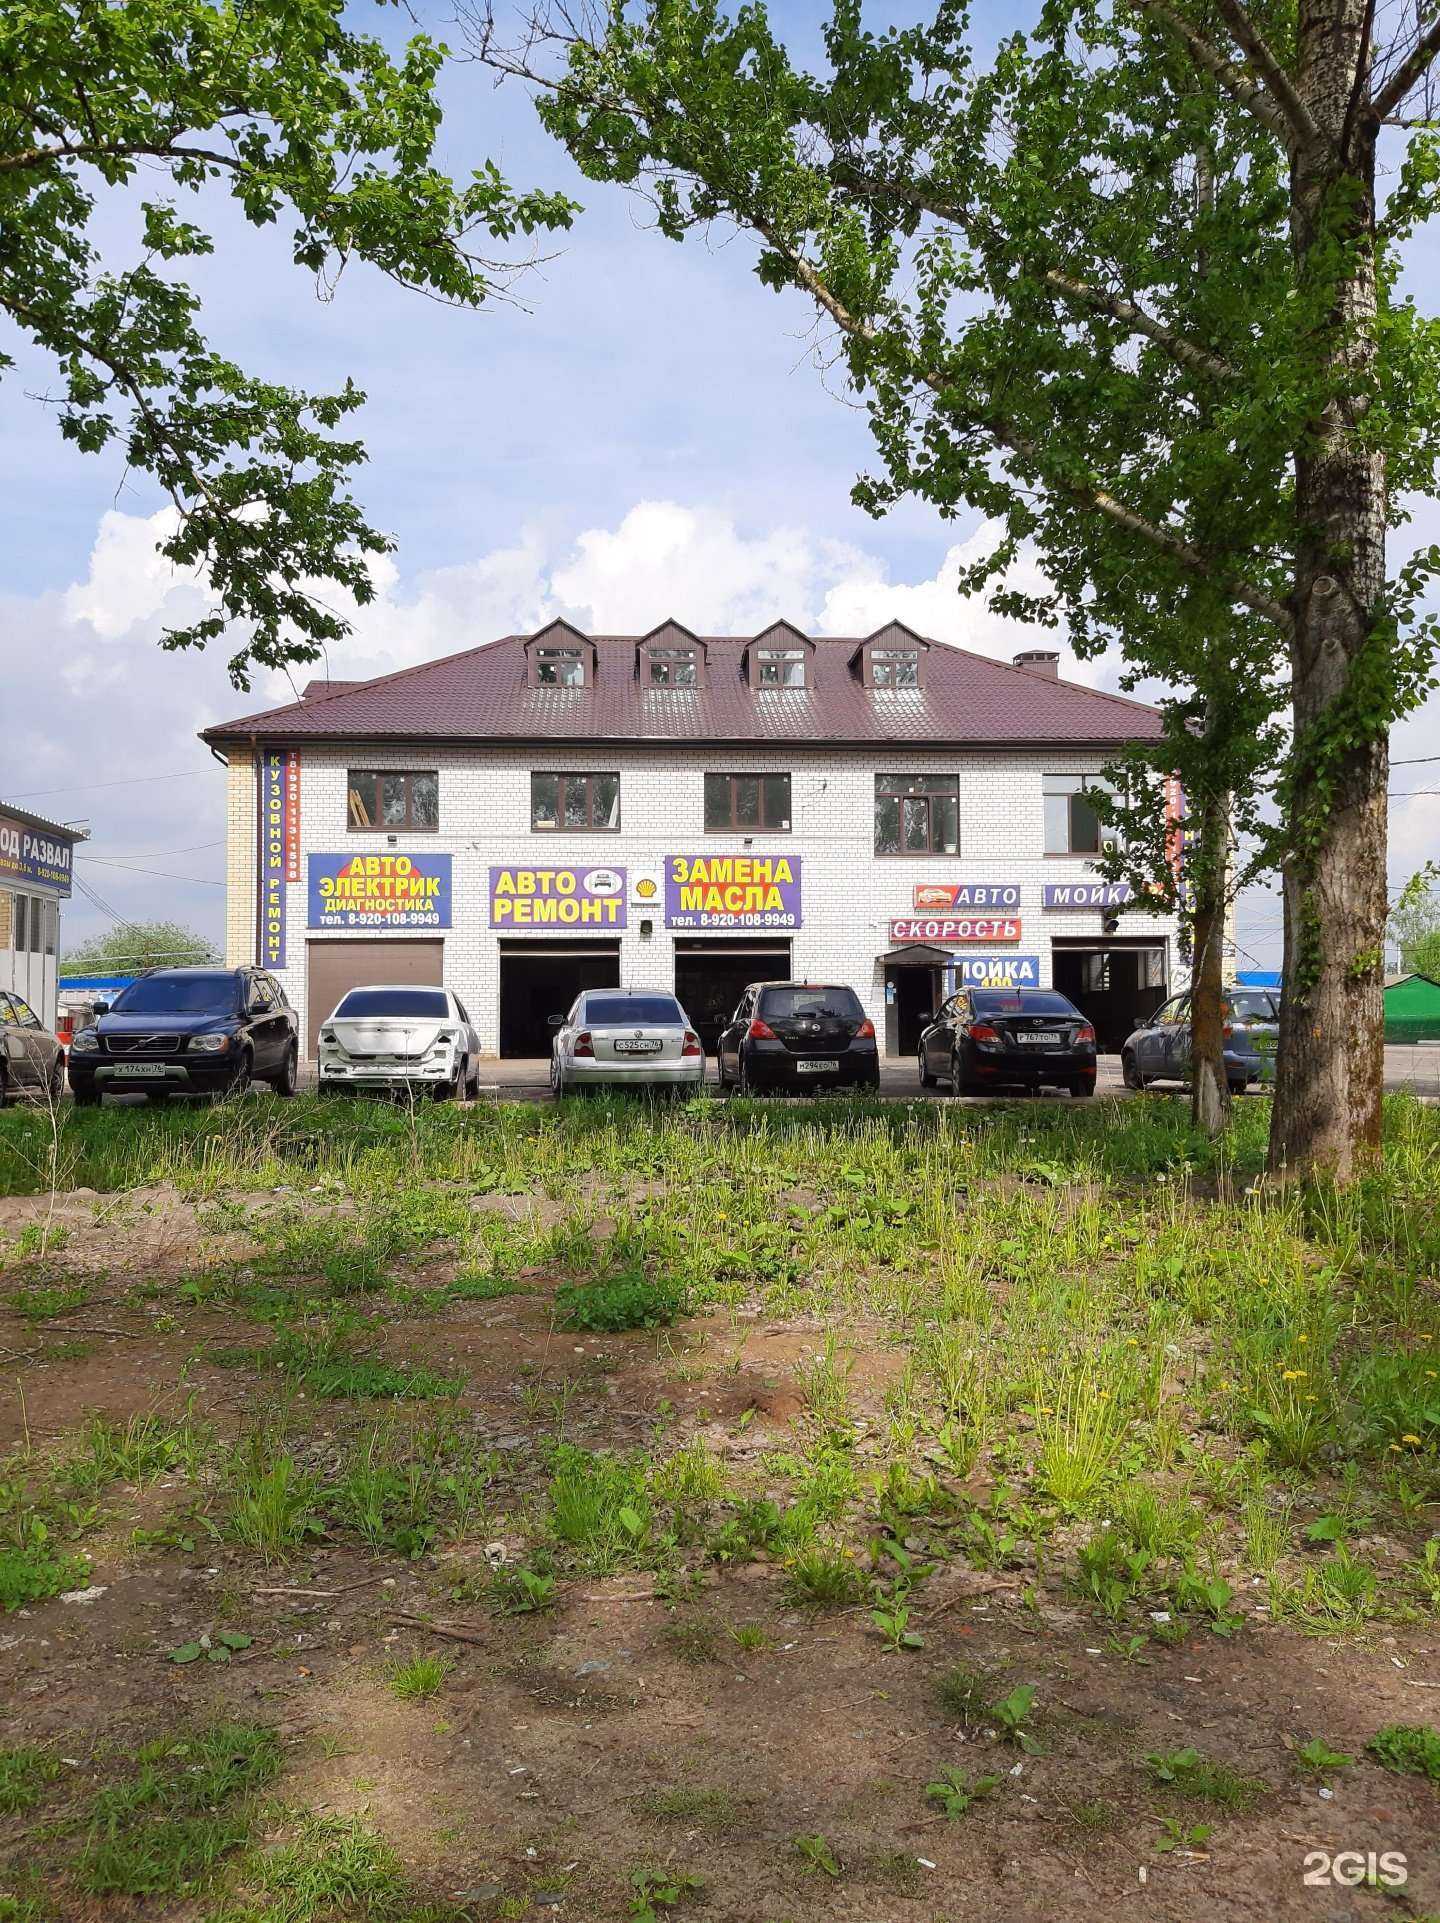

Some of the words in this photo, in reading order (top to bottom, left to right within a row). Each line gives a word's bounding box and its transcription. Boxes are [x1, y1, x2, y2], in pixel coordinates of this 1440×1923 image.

[270, 756, 282, 868] КУЗОВНОЙ
[23, 834, 70, 869] РАЗВАЛ
[349, 856, 412, 876] АВТО
[672, 857, 794, 883] ЗАМЕНА
[319, 877, 441, 897] ЭЛЕКТРИК
[495, 871, 577, 895] АВТО
[680, 886, 785, 911] МАСЛА
[957, 888, 1018, 905] АВТО
[1053, 886, 1136, 904] МОЙКА
[324, 898, 435, 913] ДИАГНОСТИКА
[493, 898, 623, 923] РЕМОНТ
[268, 878, 281, 962] РЕМОНТ
[320, 915, 345, 925] тел.
[348, 913, 440, 925] 8-920-108-9949
[671, 916, 697, 926] тел.
[700, 913, 795, 926] 8-920-108-9949
[893, 921, 1017, 937] СКОРОСТЬ
